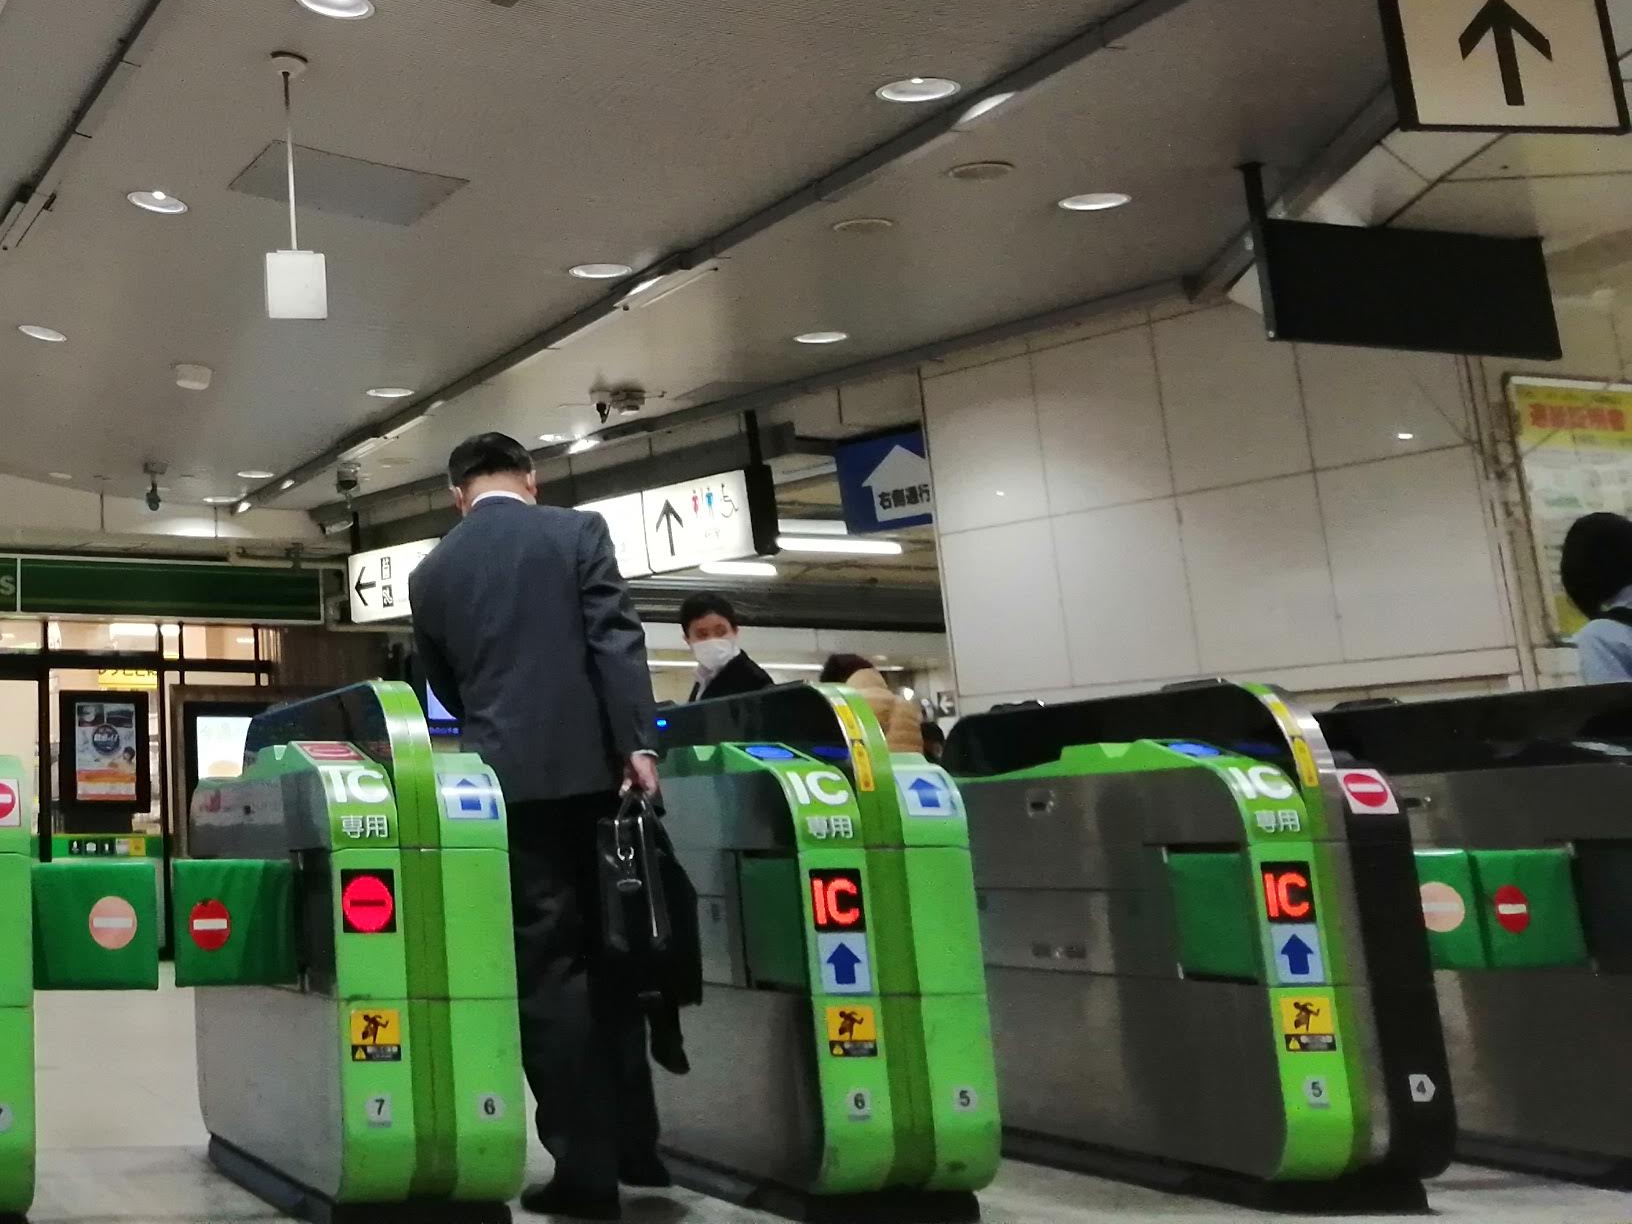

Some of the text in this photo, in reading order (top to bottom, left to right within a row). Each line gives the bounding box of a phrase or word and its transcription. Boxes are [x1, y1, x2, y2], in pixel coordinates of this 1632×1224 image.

[878, 484, 930, 510] 右側通行
[786, 770, 849, 806] IC
[340, 815, 390, 839] 専用
[811, 878, 860, 925] IC
[1264, 872, 1310, 918] IC
[959, 1089, 971, 1107] 5
[1311, 1081, 1323, 1098] 5
[374, 1099, 385, 1117] 7
[484, 1099, 495, 1117] 6
[853, 1092, 866, 1110] 6
